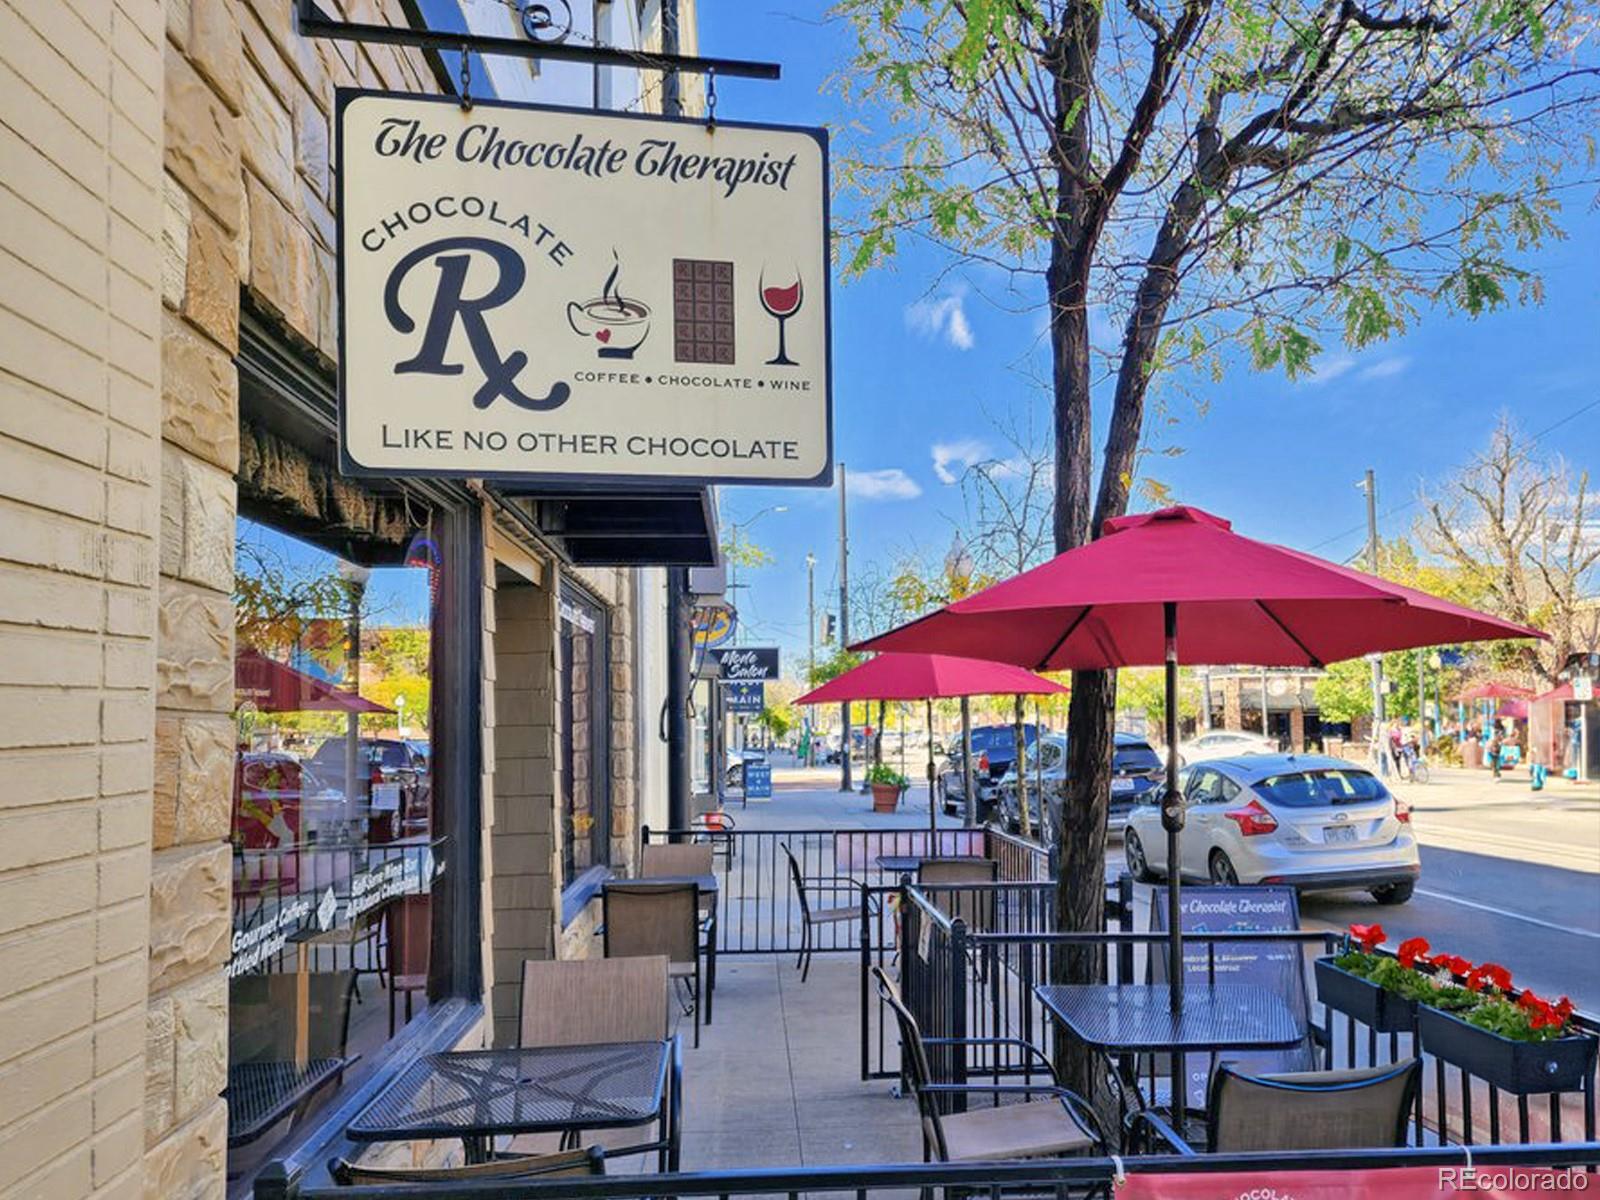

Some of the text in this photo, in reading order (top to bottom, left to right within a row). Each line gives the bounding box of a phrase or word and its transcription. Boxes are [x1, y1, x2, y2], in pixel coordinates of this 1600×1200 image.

[375, 118, 797, 198] The Chocolate Therapist
[361, 196, 575, 267] CHOCOLATE
[574, 371, 812, 391] COFFEE CHOCOLATE WINE
[464, 431, 508, 451] NO
[517, 432, 617, 455] OTHER
[627, 436, 799, 460] CHOCOLATE
[1189, 899, 1237, 915] Chocolate
[224, 944, 260, 978] ottled
